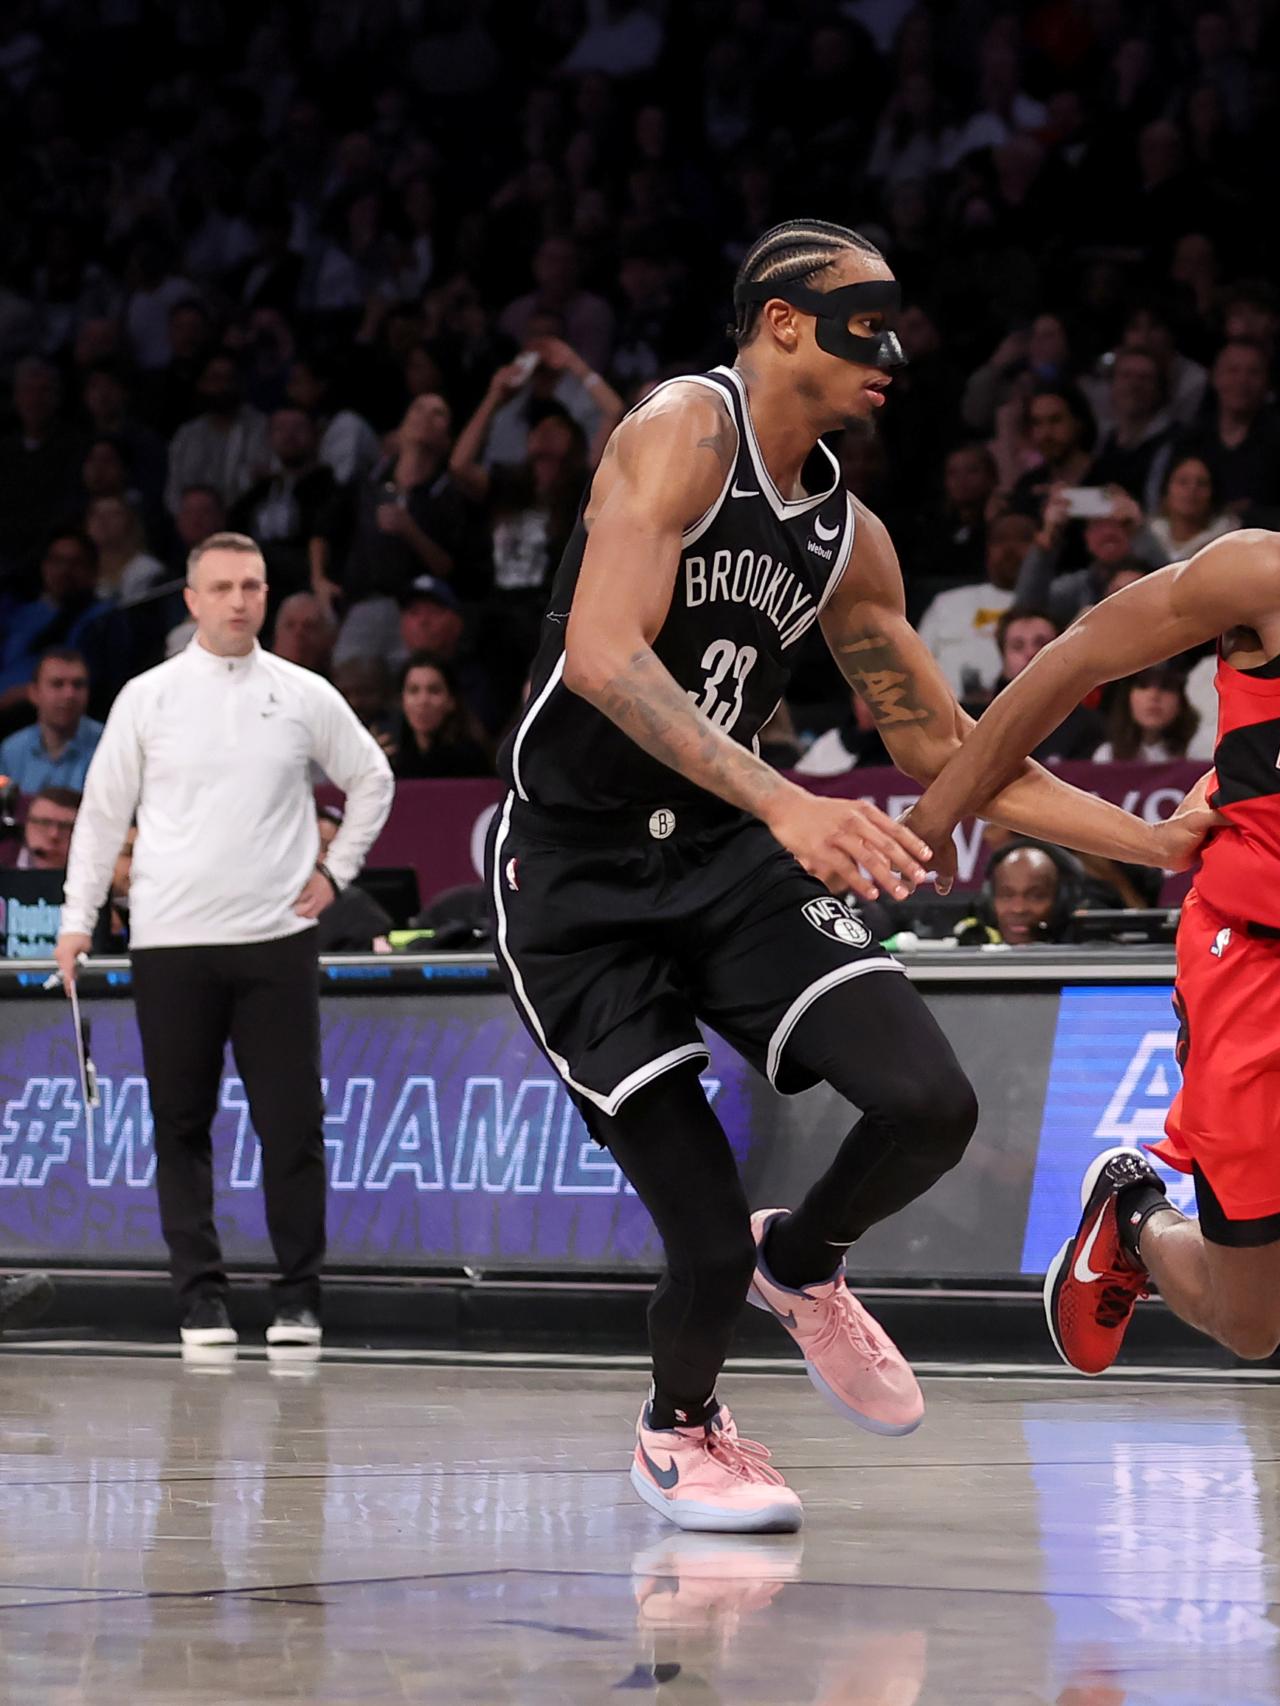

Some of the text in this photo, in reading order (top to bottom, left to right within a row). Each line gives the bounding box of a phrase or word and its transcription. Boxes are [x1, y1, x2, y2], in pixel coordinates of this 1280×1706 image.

[807, 540, 832, 561] Webull
[685, 548, 818, 650] BROOKLYN
[687, 638, 758, 736] 33
[807, 899, 850, 927] NET
